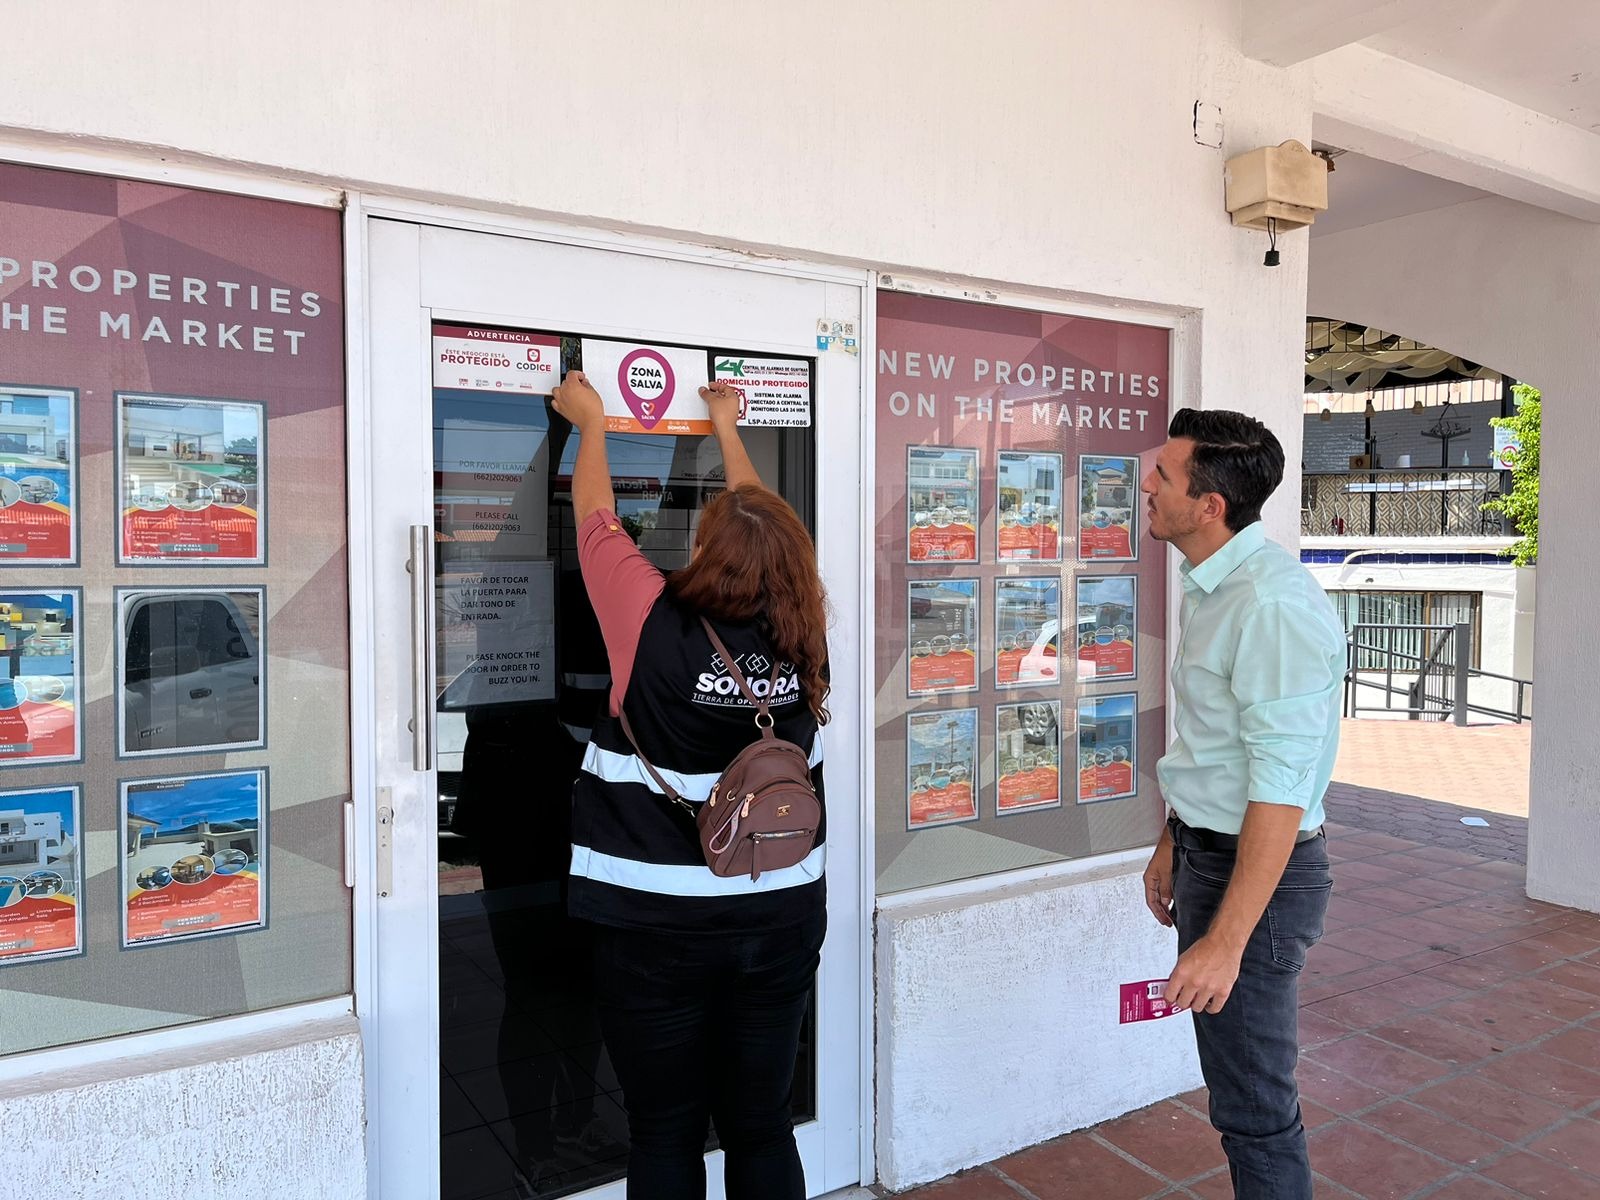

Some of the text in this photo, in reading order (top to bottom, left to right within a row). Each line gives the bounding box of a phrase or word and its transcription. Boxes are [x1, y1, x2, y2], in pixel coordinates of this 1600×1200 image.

[0, 257, 321, 317] PROPERTIES
[100, 311, 305, 355] MARKET
[467, 330, 531, 342] ADVERTENCIA
[440, 354, 511, 368] PROTEGIDO
[516, 362, 552, 372] CODICE
[631, 366, 662, 378] ZONA
[879, 349, 1160, 398] NEW PROPERTIES
[630, 379, 663, 390] SALVA
[717, 378, 808, 388] DOMICILIO PROTEGIDO
[889, 391, 1149, 431] ON THE MARKET
[459, 460, 536, 473] POR FAVOR LLAMA AL
[475, 511, 519, 520] PLEASE CALL
[460, 576, 529, 585] FAVOR DE TOCAR
[460, 588, 527, 597] LA PUERTA PARA
[460, 600, 516, 609] DAR TONO DE
[461, 613, 502, 621] ENTRADA.
[465, 651, 540, 661] PLEASE KNOCK THE
[465, 663, 540, 673] DOOR IN ORDER TO
[488, 675, 540, 685] BUZZ YOU IN.
[692, 692, 722, 704] TIERRA
[723, 697, 735, 705] DE
